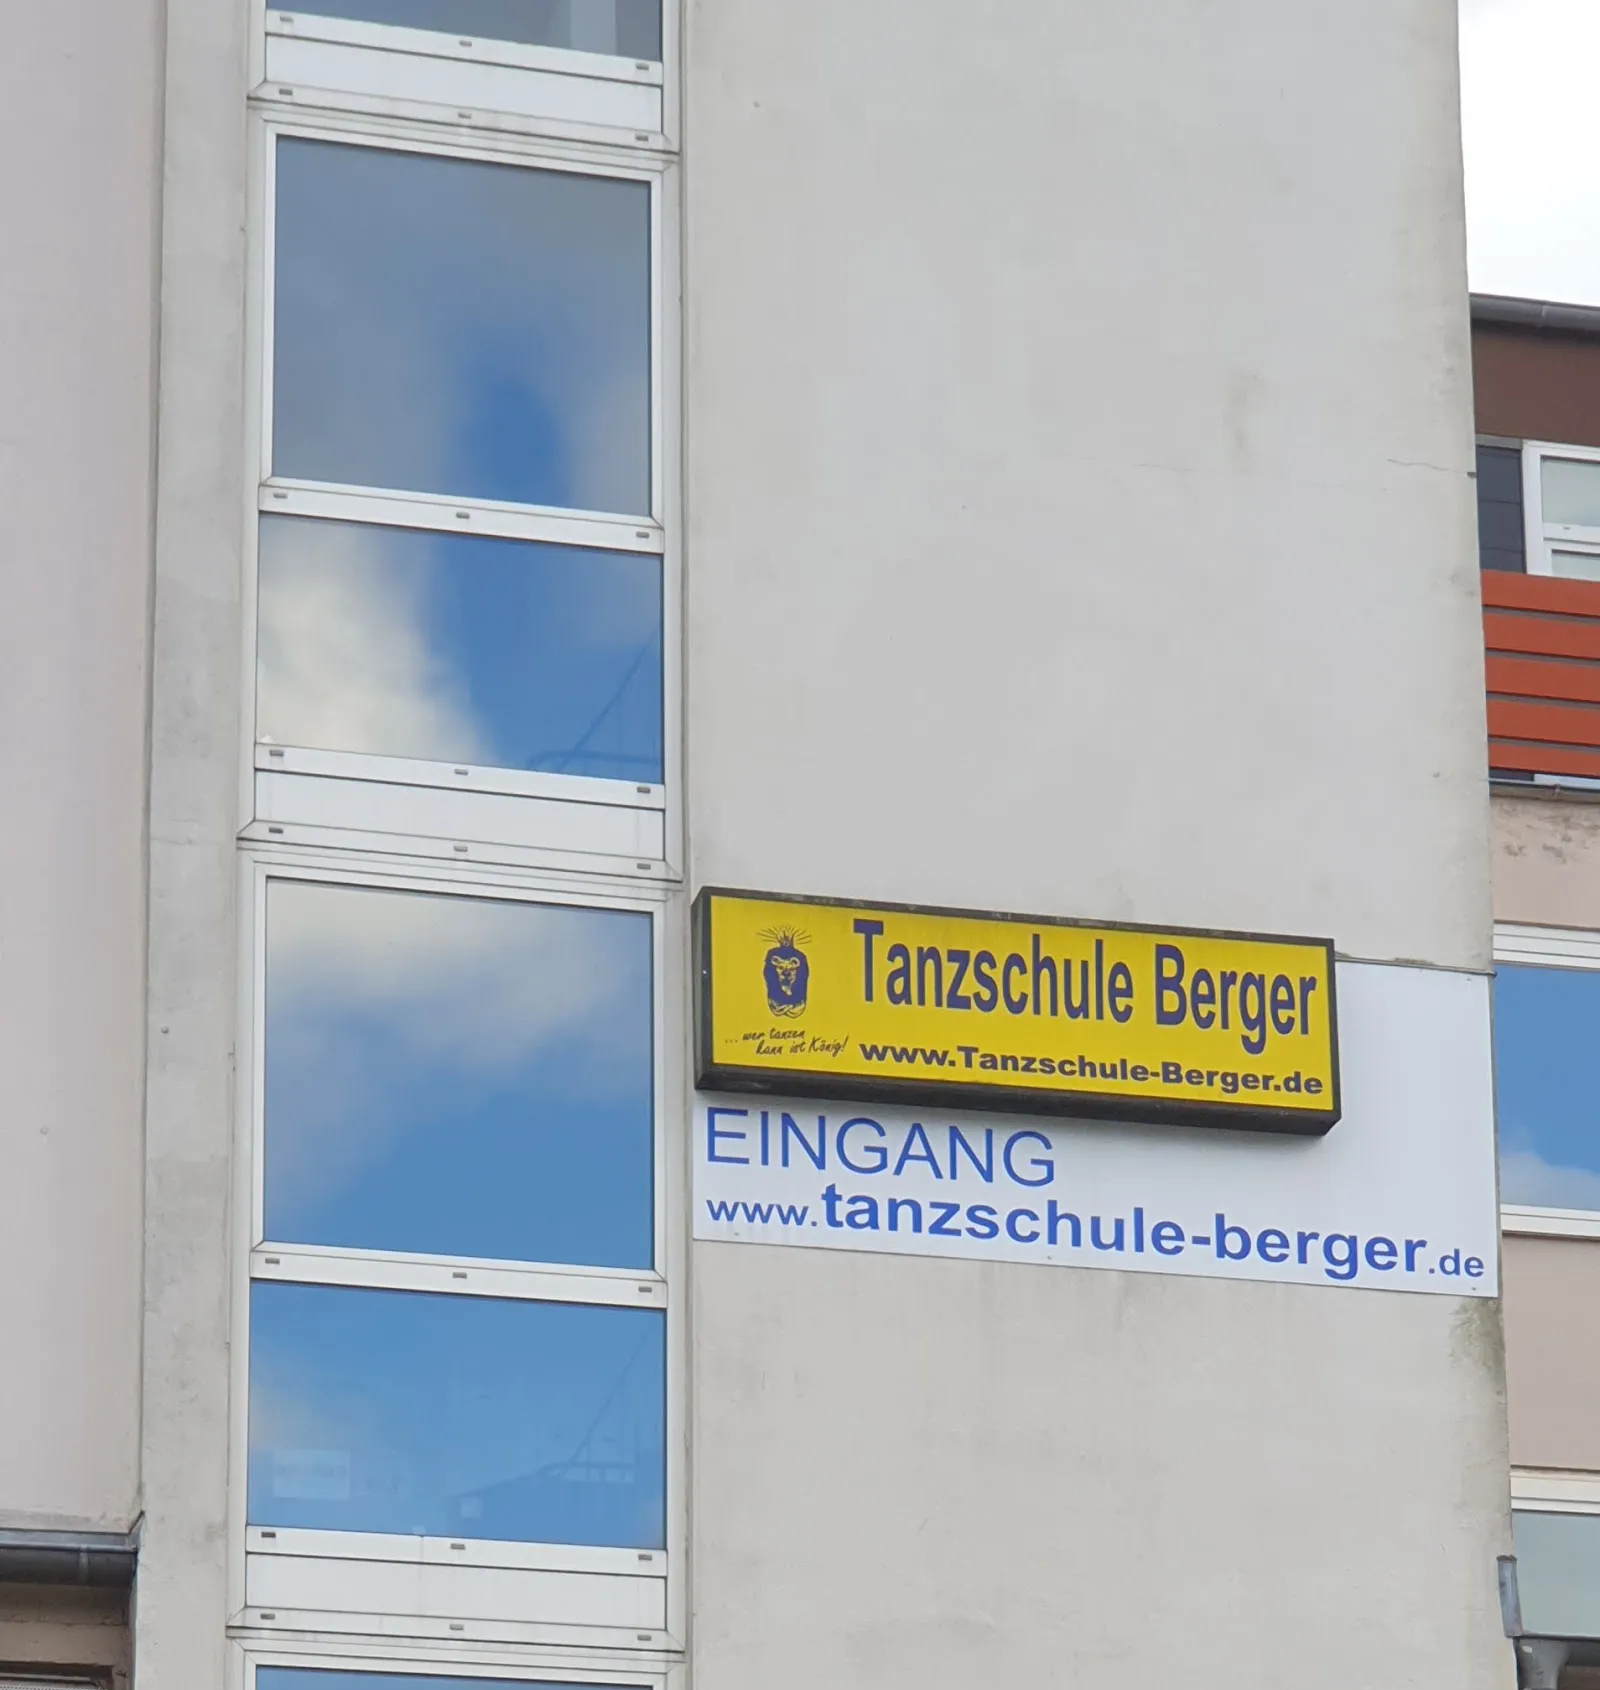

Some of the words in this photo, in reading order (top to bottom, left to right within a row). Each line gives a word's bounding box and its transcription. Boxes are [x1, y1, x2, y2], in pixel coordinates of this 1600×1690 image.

[853, 919, 1134, 1024] Tanzschule
[1154, 943, 1319, 1055] Berger
[859, 1041, 1324, 1096] www.Tanzschule-Berger.de
[706, 1107, 1056, 1187] EINGANG
[706, 1183, 1485, 1280] www.tanzschule-berger.de
